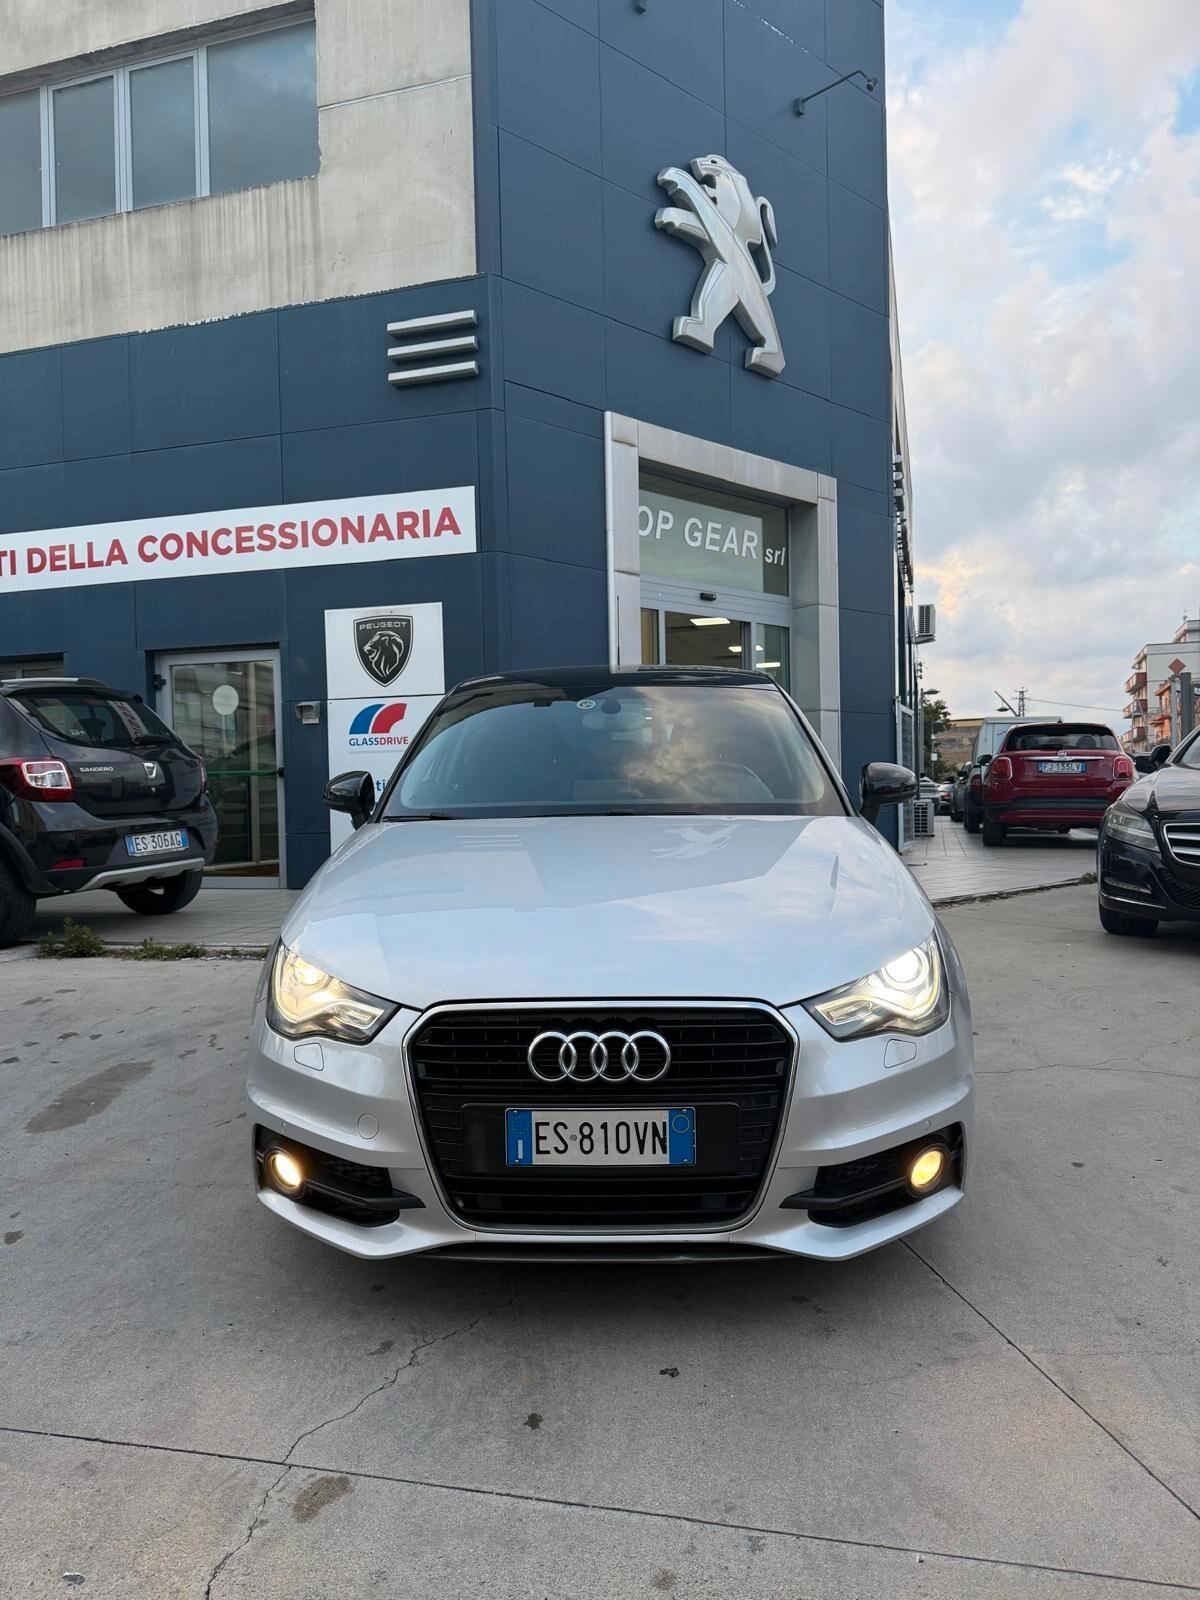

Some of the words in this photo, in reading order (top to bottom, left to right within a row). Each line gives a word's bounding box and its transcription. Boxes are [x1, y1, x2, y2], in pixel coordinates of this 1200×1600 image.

[26, 538, 129, 574] DELLA
[138, 507, 462, 564] CONCESSIONARIA
[684, 517, 759, 559] GEAR
[764, 546, 786, 566] srl
[359, 621, 407, 630] PEUGEOT
[348, 736, 409, 747] GLASSDRIVE
[534, 1121, 569, 1155] ES
